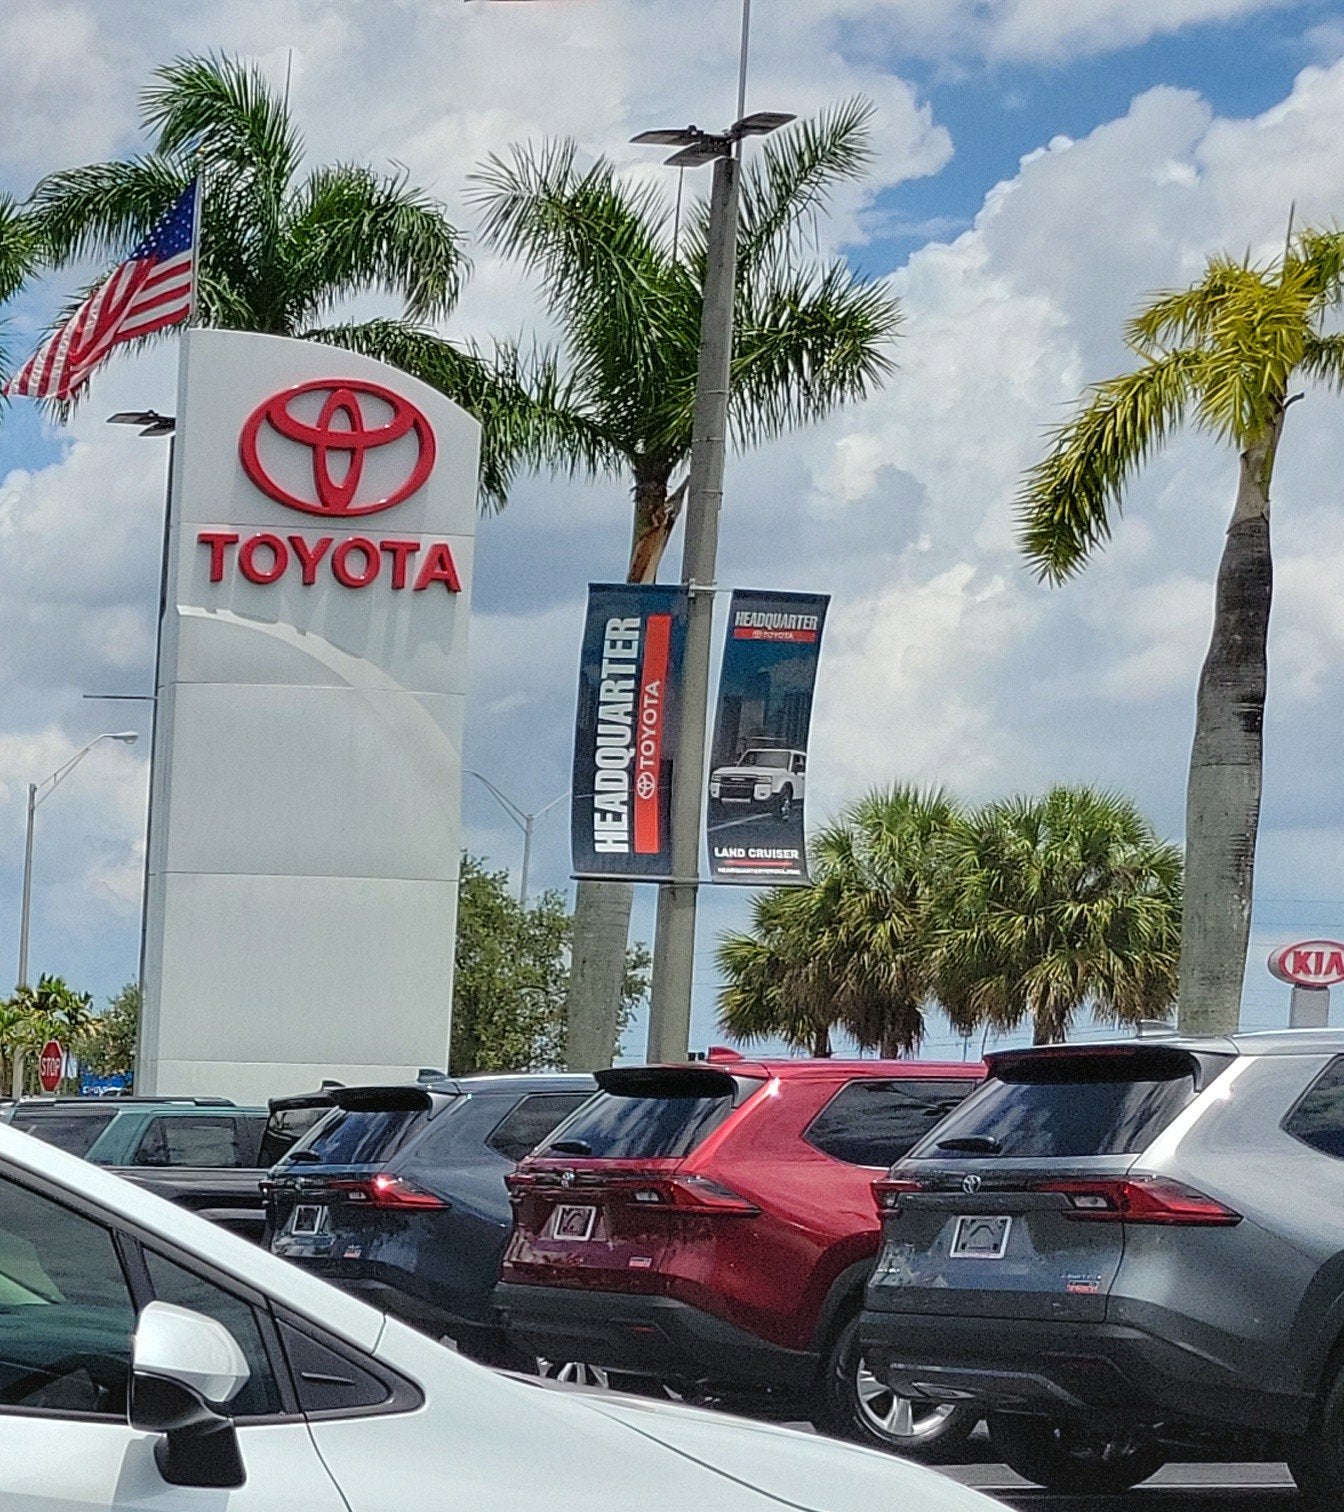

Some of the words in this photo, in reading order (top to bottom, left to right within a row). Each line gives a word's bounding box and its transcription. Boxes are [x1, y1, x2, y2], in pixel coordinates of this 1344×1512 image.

[197, 532, 462, 594] TOYOTA
[735, 611, 819, 630] HEADQUARTER
[593, 616, 642, 853] HEADQUARTER
[639, 680, 660, 770] TOYOTA
[714, 847, 746, 857] LAND
[748, 848, 800, 859] CRUISER
[1293, 951, 1344, 975] KIA
[41, 1057, 60, 1077] STOP
